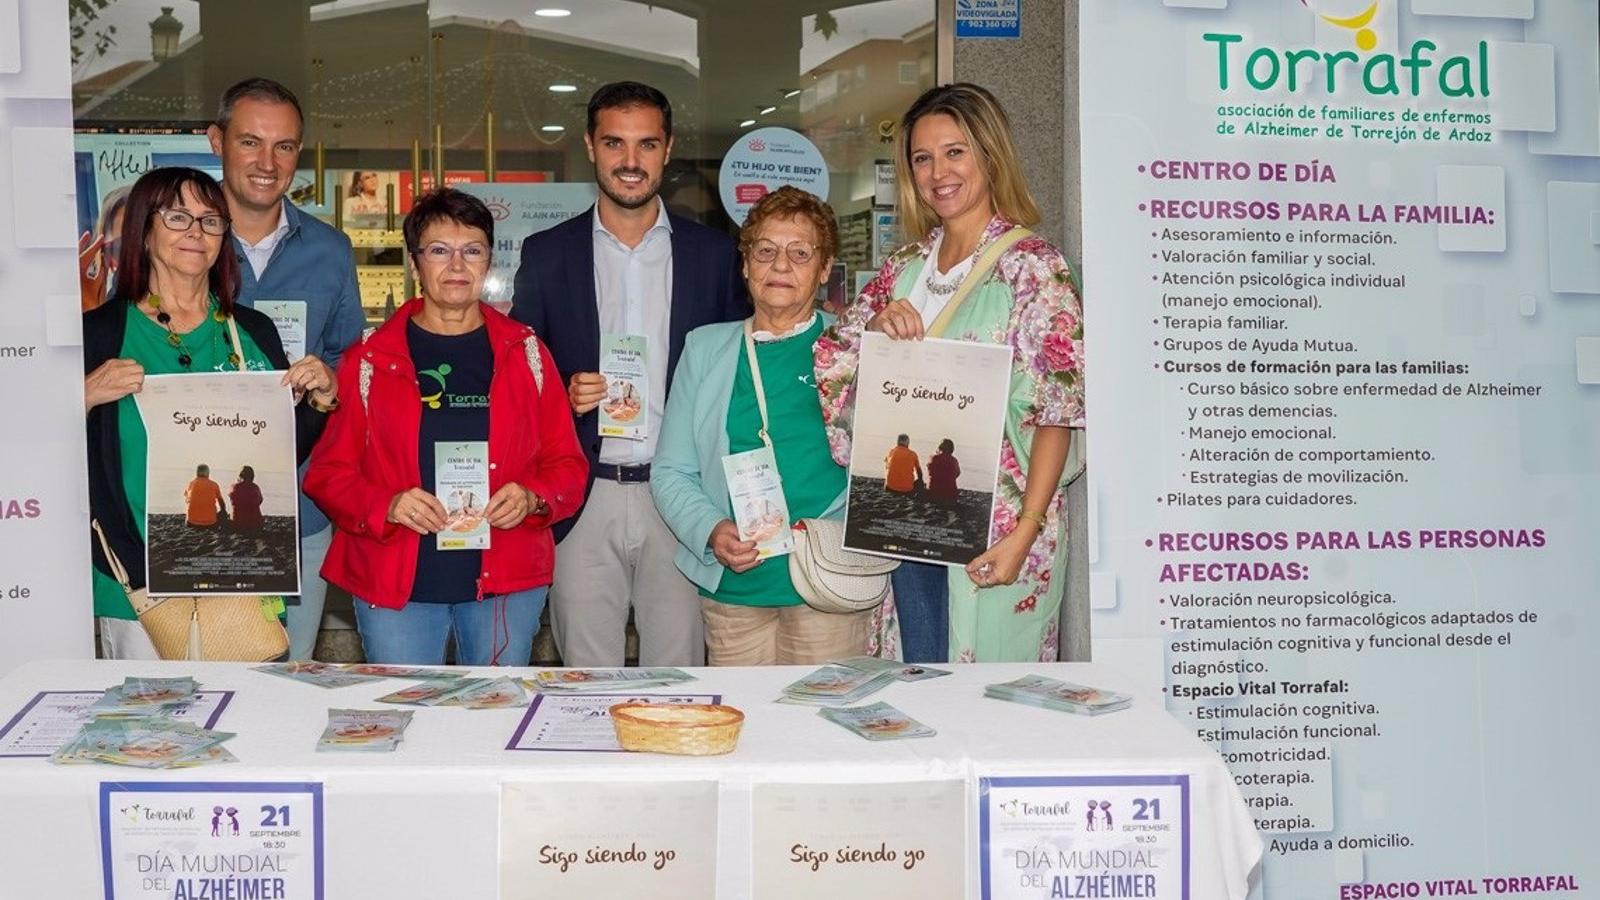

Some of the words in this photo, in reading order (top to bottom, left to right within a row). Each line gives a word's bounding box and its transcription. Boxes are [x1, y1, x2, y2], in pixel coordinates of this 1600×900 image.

[976, 0, 998, 8] ZONA
[1203, 33, 1490, 98] Torrafal
[1217, 104, 1294, 119] asociación
[1297, 105, 1315, 118] de
[1321, 105, 1395, 121] familiares
[1402, 108, 1419, 122] de
[1424, 108, 1491, 124] enfermos
[1217, 121, 1235, 134] de
[1245, 122, 1318, 137] Alzheimer
[1326, 124, 1343, 138] de
[1351, 125, 1416, 143] Torrejón
[1423, 127, 1440, 140] de
[1449, 128, 1491, 142] Ardoz
[751, 163, 776, 172] HIJO
[778, 164, 792, 173] VE
[793, 165, 823, 176] BIEN?
[1151, 160, 1250, 180] CENTRO
[1259, 163, 1287, 181] DE
[1295, 160, 1336, 183] DÍA
[1151, 200, 1280, 220] RECURSOS
[1288, 203, 1350, 221] PARA
[1359, 204, 1386, 222] LA
[1395, 205, 1494, 224] FAMILIA:
[497, 238, 522, 251] HIJ
[1162, 228, 1281, 242] Asesoramiento
[1286, 233, 1294, 242] e
[1300, 230, 1396, 244] información.
[1162, 250, 1246, 263] Valoración
[1251, 250, 1309, 264] familiar
[1314, 255, 1322, 268] y
[1328, 253, 1375, 265] social.
[1162, 272, 1235, 287] Atención
[1240, 272, 1325, 289] psicológica
[1331, 273, 1405, 287] individual
[1163, 293, 1228, 310] (manejo
[1233, 295, 1321, 310] emocional).
[1163, 316, 1222, 332] Terapia
[1228, 316, 1287, 329] familiar.
[1163, 338, 1223, 354] Grupos
[1228, 338, 1247, 351] de
[1252, 339, 1298, 354] Ayuda
[1304, 340, 1357, 352] Mutua.
[1164, 360, 1221, 372] Cursos
[1227, 360, 1246, 372] de
[1250, 360, 1331, 373] formación
[1336, 364, 1370, 376] para
[1376, 361, 1397, 374] las
[1402, 361, 1468, 374] familias:
[882, 381, 908, 402] Sigo
[912, 386, 954, 402] siendo
[958, 395, 975, 410] yo
[1188, 383, 1235, 395] Curso
[1241, 382, 1289, 395] básico
[1294, 383, 1338, 395] sobre
[1343, 383, 1437, 395] enfermedad
[1442, 384, 1461, 396] de
[1467, 383, 1541, 396] Alzheimer
[445, 394, 489, 404] Torra
[1188, 407, 1197, 420] y
[1203, 406, 1244, 417] otras
[1249, 404, 1336, 417] demencias.
[173, 411, 201, 431] Sigo
[206, 413, 248, 428] siendo
[252, 421, 267, 435] yo
[1190, 426, 1246, 442] Manejo
[1252, 426, 1336, 439] emocional.
[1190, 448, 1269, 461] Alteración
[1274, 449, 1293, 461] de
[1299, 448, 1434, 464] comportamiento.
[1191, 470, 1278, 487] Estrategias
[1283, 470, 1302, 483] de
[1308, 469, 1408, 483] movilización.
[1168, 492, 1222, 506] Pilates
[1228, 495, 1260, 508] para
[1266, 492, 1356, 505] cuidadores.
[1159, 532, 1288, 551] RECURSOS
[1297, 531, 1360, 550] PARA
[1368, 531, 1411, 549] LAS
[1420, 529, 1545, 548] PERSONAS
[1160, 562, 1308, 582] AFECTADAS:
[8, 585, 31, 599] de
[1170, 593, 1252, 607] Valoración
[1257, 591, 1396, 609] neuropsicológica.
[1170, 615, 1276, 629] Tratamientos
[1282, 617, 1301, 627] no
[1306, 612, 1426, 629] farmacológicos
[1431, 611, 1513, 627] adaptados
[1519, 610, 1537, 622] de
[1171, 637, 1272, 652] estimulación
[1278, 635, 1350, 653] cognitiva
[1355, 639, 1364, 652] y
[1369, 634, 1440, 647] funcional
[1446, 633, 1492, 646] desde
[1498, 632, 1510, 645] el
[1171, 659, 1268, 678] diagnóstico.
[1173, 682, 1234, 700] Espacio
[1239, 681, 1275, 695] Vital
[1281, 680, 1348, 694] Torrafal:
[1197, 703, 1297, 719] Estimulación
[1303, 701, 1379, 719] cognitiva.
[1198, 726, 1298, 741] Estimulación
[1303, 723, 1380, 738] funcional.
[1216, 747, 1331, 763] comotricidad.
[1231, 770, 1314, 787] coterapia.
[260, 806, 290, 827] 21
[1132, 799, 1160, 820] 21
[1270, 838, 1318, 855] Ayuda
[1324, 840, 1332, 849] a
[1338, 833, 1414, 849] domicilio.
[138, 850, 175, 873] DÍA
[182, 855, 286, 873] MUNDIAL
[539, 845, 578, 872] Sigo
[585, 843, 646, 863] siendo
[654, 850, 675, 870] yo
[791, 844, 828, 871] Sigo
[836, 843, 896, 863] siendo
[904, 850, 925, 869] yo
[1016, 846, 1051, 869] DÍA
[1058, 850, 1158, 869] MUNDIAL
[143, 878, 170, 891] DEL
[175, 875, 285, 900] ALZHÉIMER
[1021, 875, 1048, 887] DEL
[1051, 871, 1156, 899] ALZHÉIMER
[1340, 882, 1421, 900] ESPACIO
[1425, 879, 1478, 897] VITAL
[1482, 875, 1579, 893] TORRAFAL
